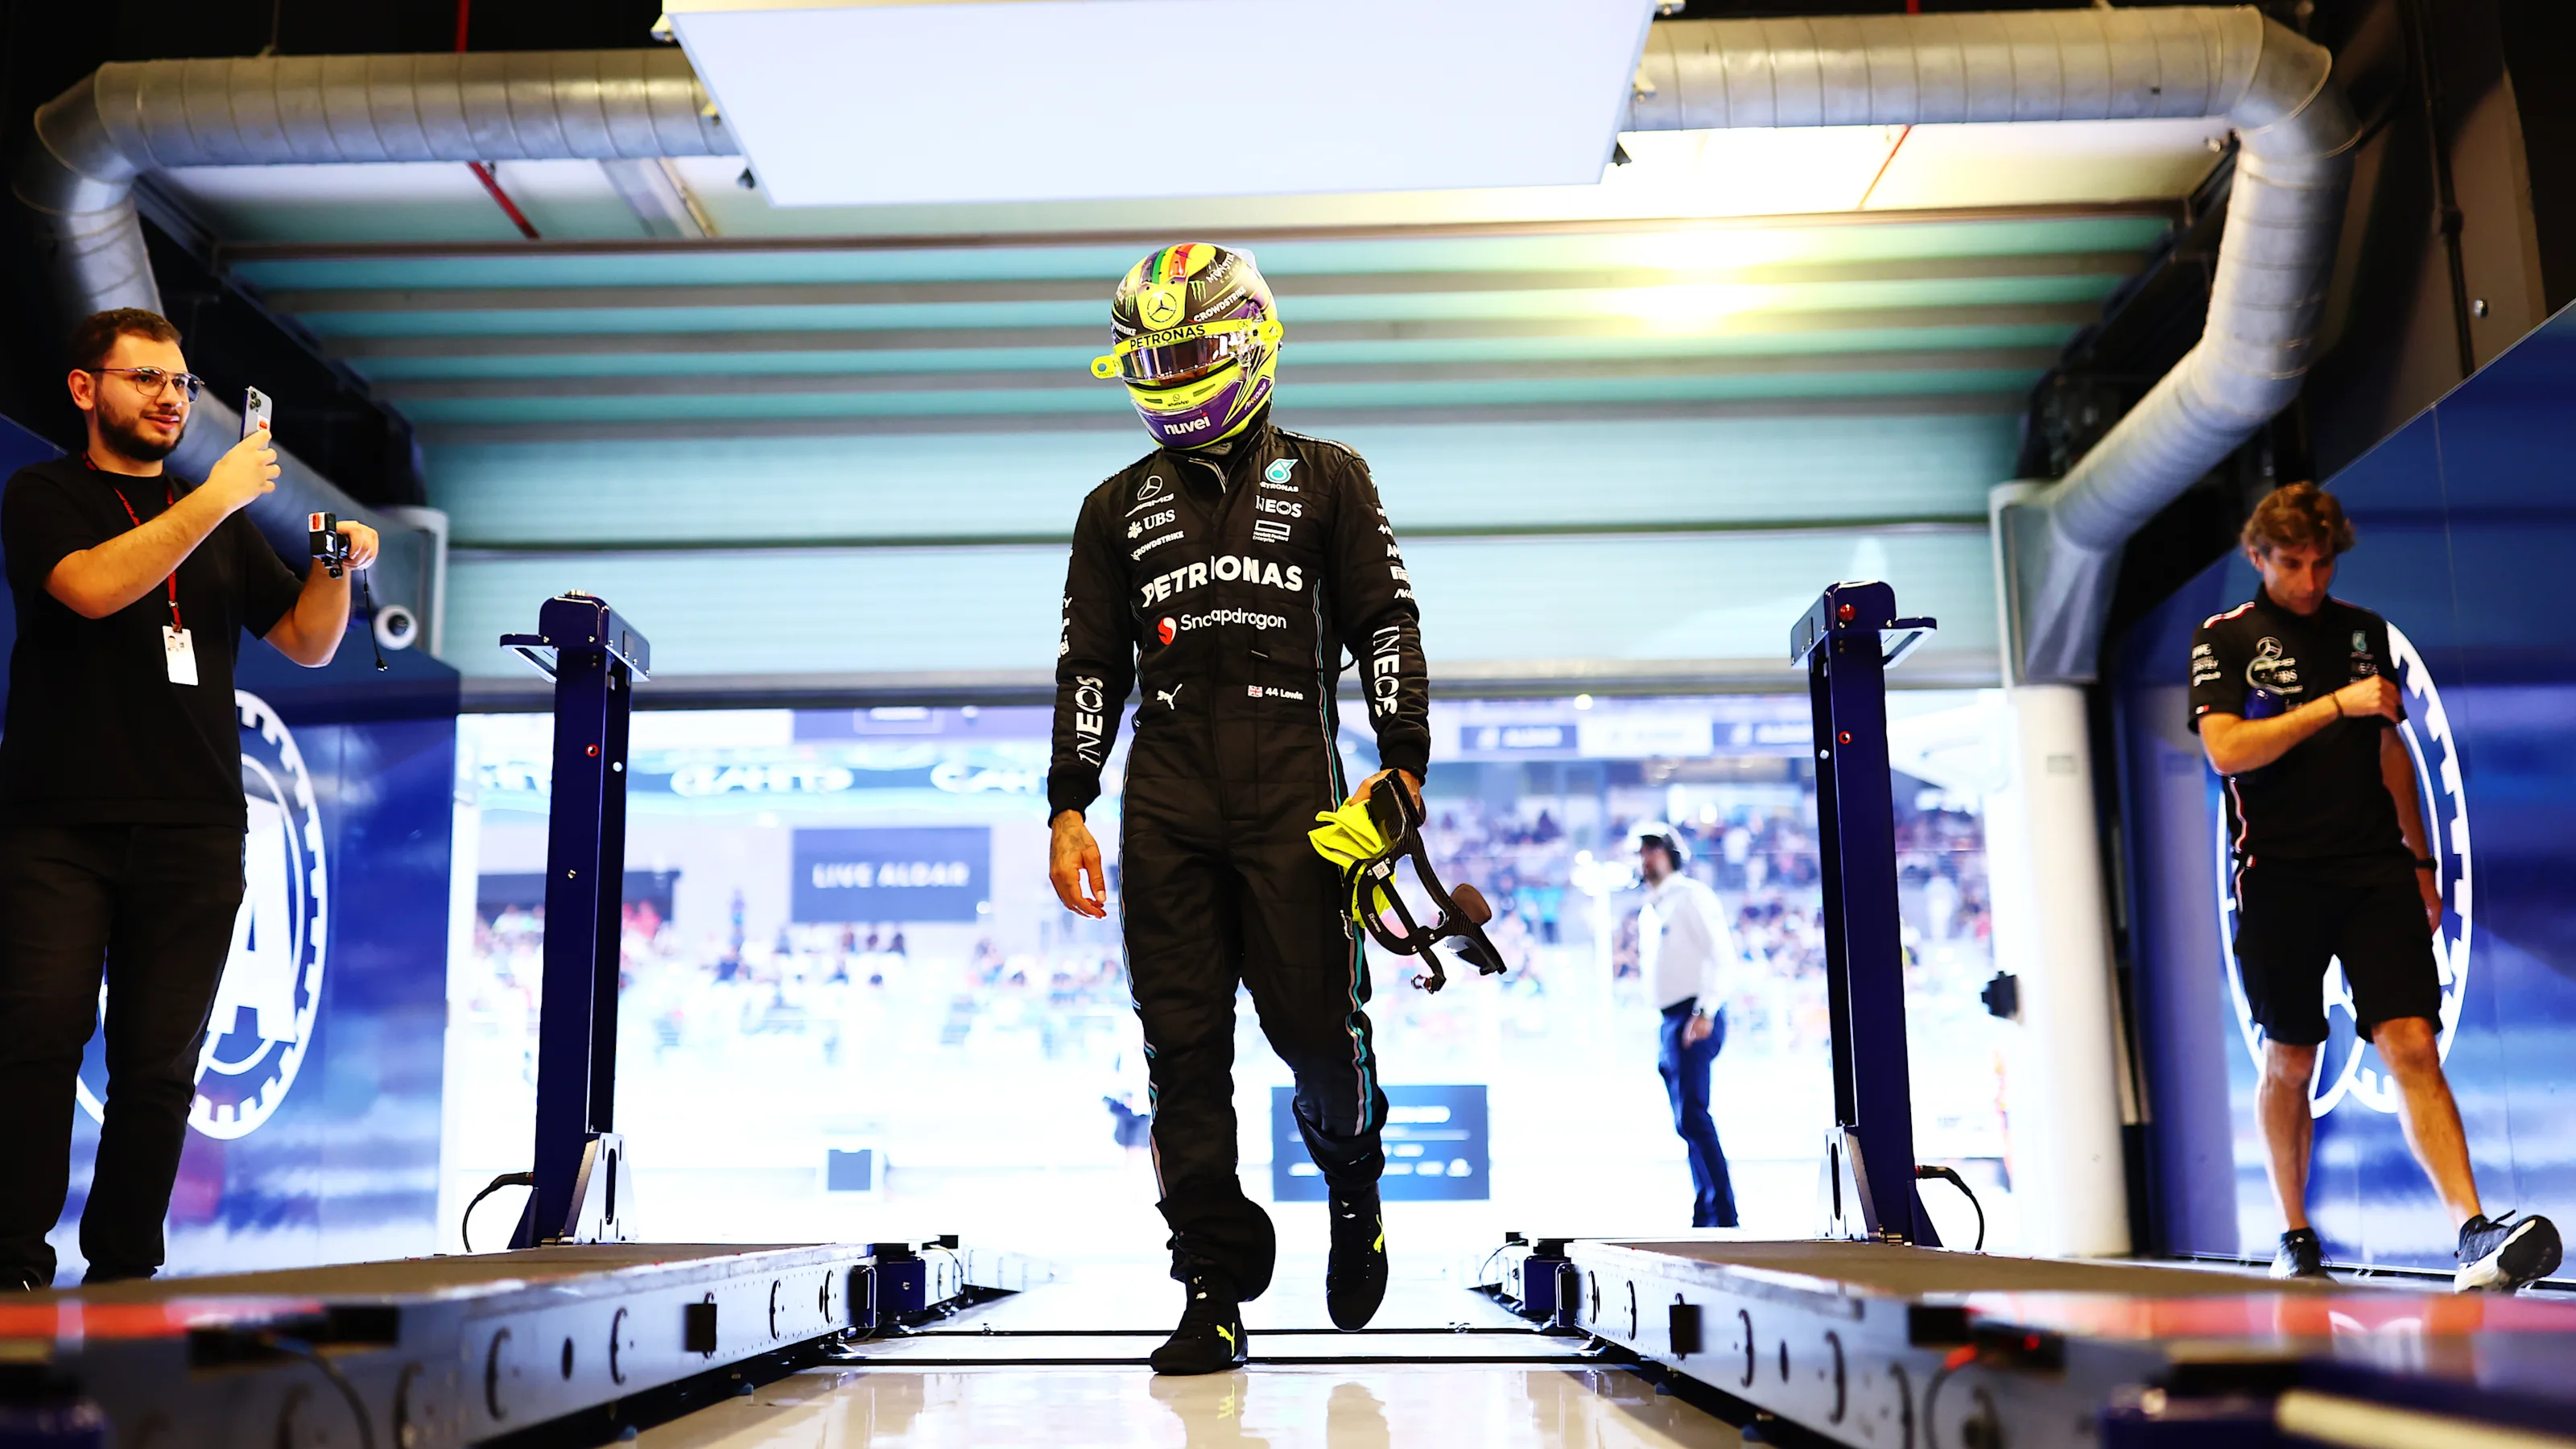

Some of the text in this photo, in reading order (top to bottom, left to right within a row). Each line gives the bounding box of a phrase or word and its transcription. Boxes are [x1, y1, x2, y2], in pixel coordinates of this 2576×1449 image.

[1193, 285, 1247, 322] CROWDSTRIKE
[1129, 324, 1206, 350] PETRONAS
[1163, 412, 1211, 435] nuvei
[1143, 509, 1175, 530] UBS
[1133, 530, 1184, 558] CROWDSTRIKE
[1141, 555, 1303, 608] PETRONAS
[1180, 608, 1286, 630] Snapdragon
[1373, 625, 1400, 718] INEOS
[1265, 687, 1303, 700] 44 Lewis
[1075, 675, 1104, 769] INEOS
